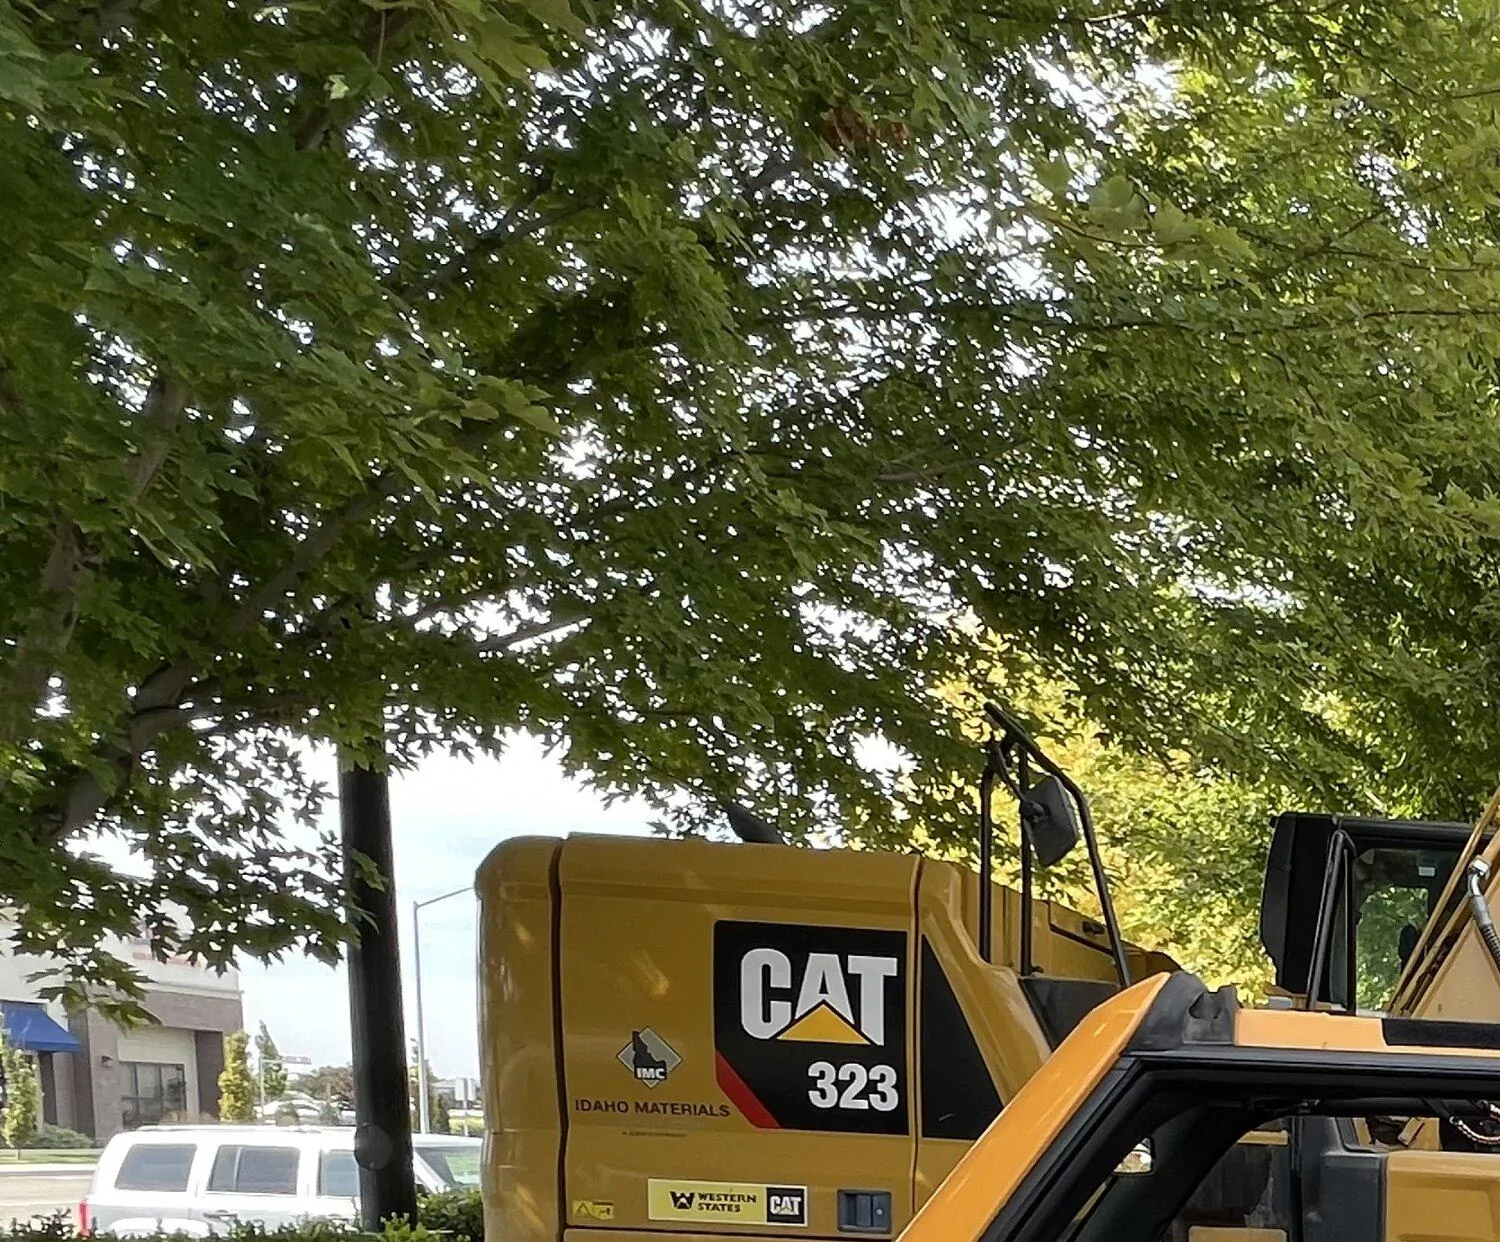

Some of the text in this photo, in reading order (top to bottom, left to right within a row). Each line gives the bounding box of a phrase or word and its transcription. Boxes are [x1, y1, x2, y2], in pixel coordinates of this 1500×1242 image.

[740, 947, 898, 1047] CAT
[636, 1067, 665, 1079] IMC
[807, 1061, 899, 1112] 323
[575, 1099, 730, 1117] IDAHO MATERIALS
[698, 1192, 757, 1204] WESTERN
[769, 1195, 802, 1216] CAT
[697, 1202, 741, 1213] STATES
